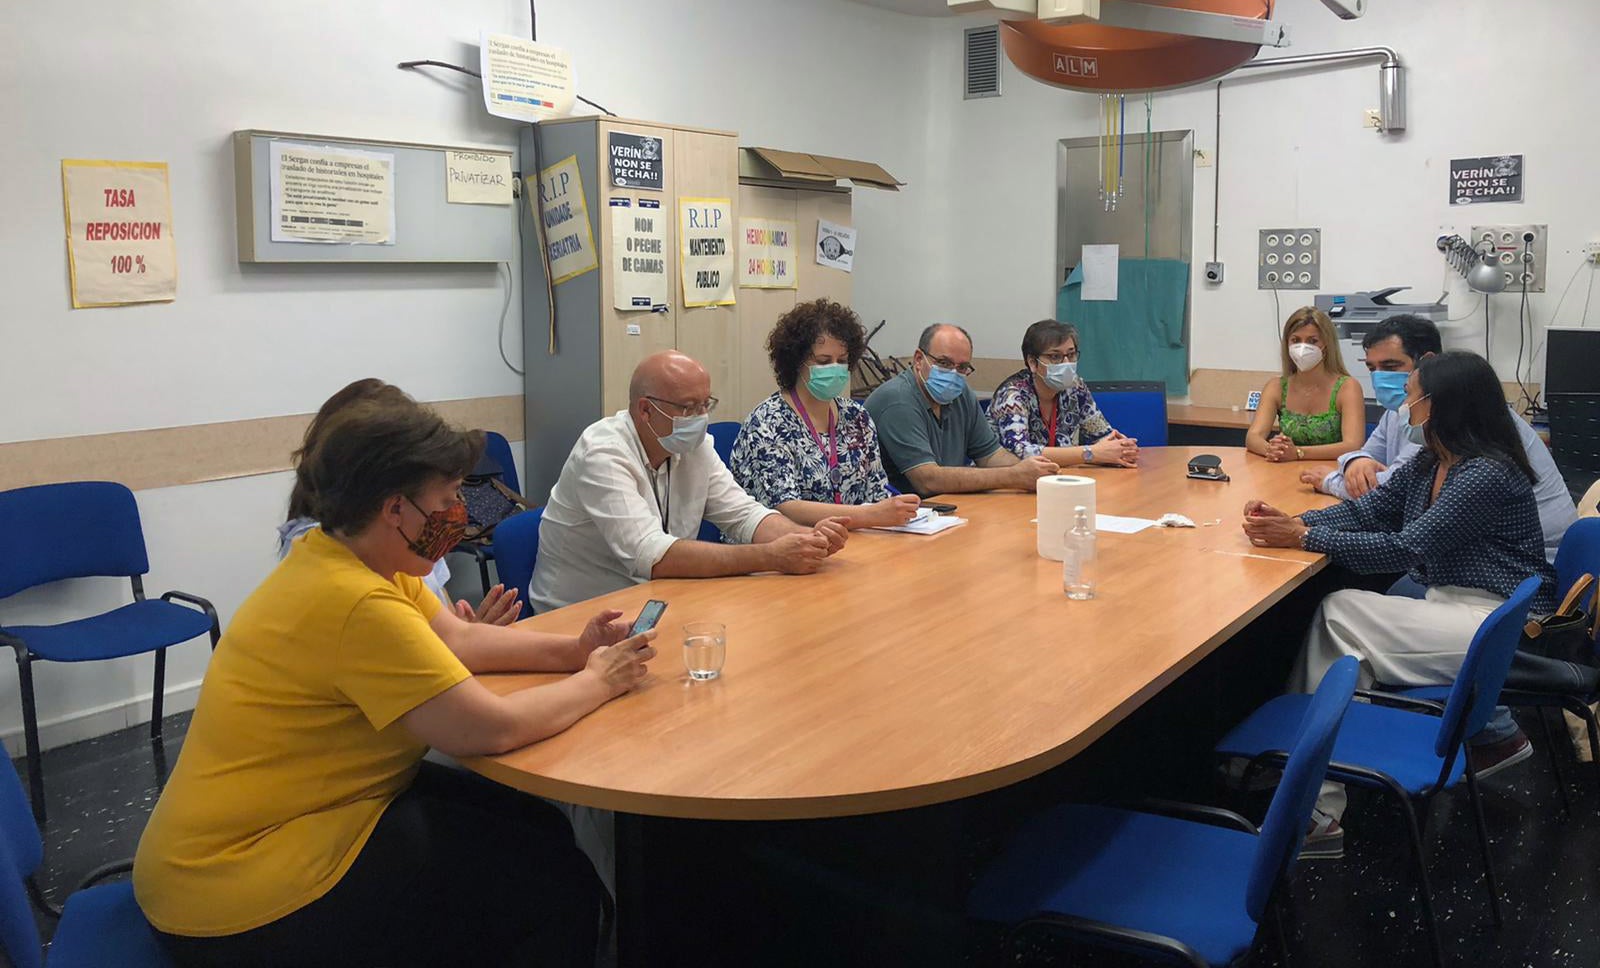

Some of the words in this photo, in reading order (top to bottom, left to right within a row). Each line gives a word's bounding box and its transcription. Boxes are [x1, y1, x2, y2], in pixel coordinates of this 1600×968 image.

[1056, 57, 1096, 74] ALM
[611, 145, 641, 158] VERÍN
[289, 155, 308, 164] Sergas
[335, 161, 362, 171] empresas
[614, 158, 638, 168] NON
[640, 161, 652, 170] SE
[307, 166, 314, 174] de
[316, 166, 346, 176] historiales
[357, 172, 384, 180] hospitales
[614, 168, 658, 180] PECHA!!
[1452, 167, 1494, 180] VERÍN
[1457, 180, 1488, 188] NON
[1492, 178, 1508, 187] SE
[1457, 186, 1516, 196] PECHA!!
[104, 188, 136, 208] TASA
[544, 201, 574, 228] UNIDADE
[688, 208, 722, 228] R.I.P
[86, 222, 162, 240] REPOSICION
[634, 216, 654, 233] NON
[626, 237, 632, 252] O
[634, 238, 662, 254] PECHE
[689, 238, 726, 256] MANTEMENTO
[111, 256, 132, 274] 100
[136, 255, 146, 274] %
[622, 257, 632, 272] DE
[634, 258, 664, 274] CAMAS
[748, 258, 756, 276] 24
[756, 259, 776, 276] HORAS
[696, 270, 720, 288] PUBLICO
